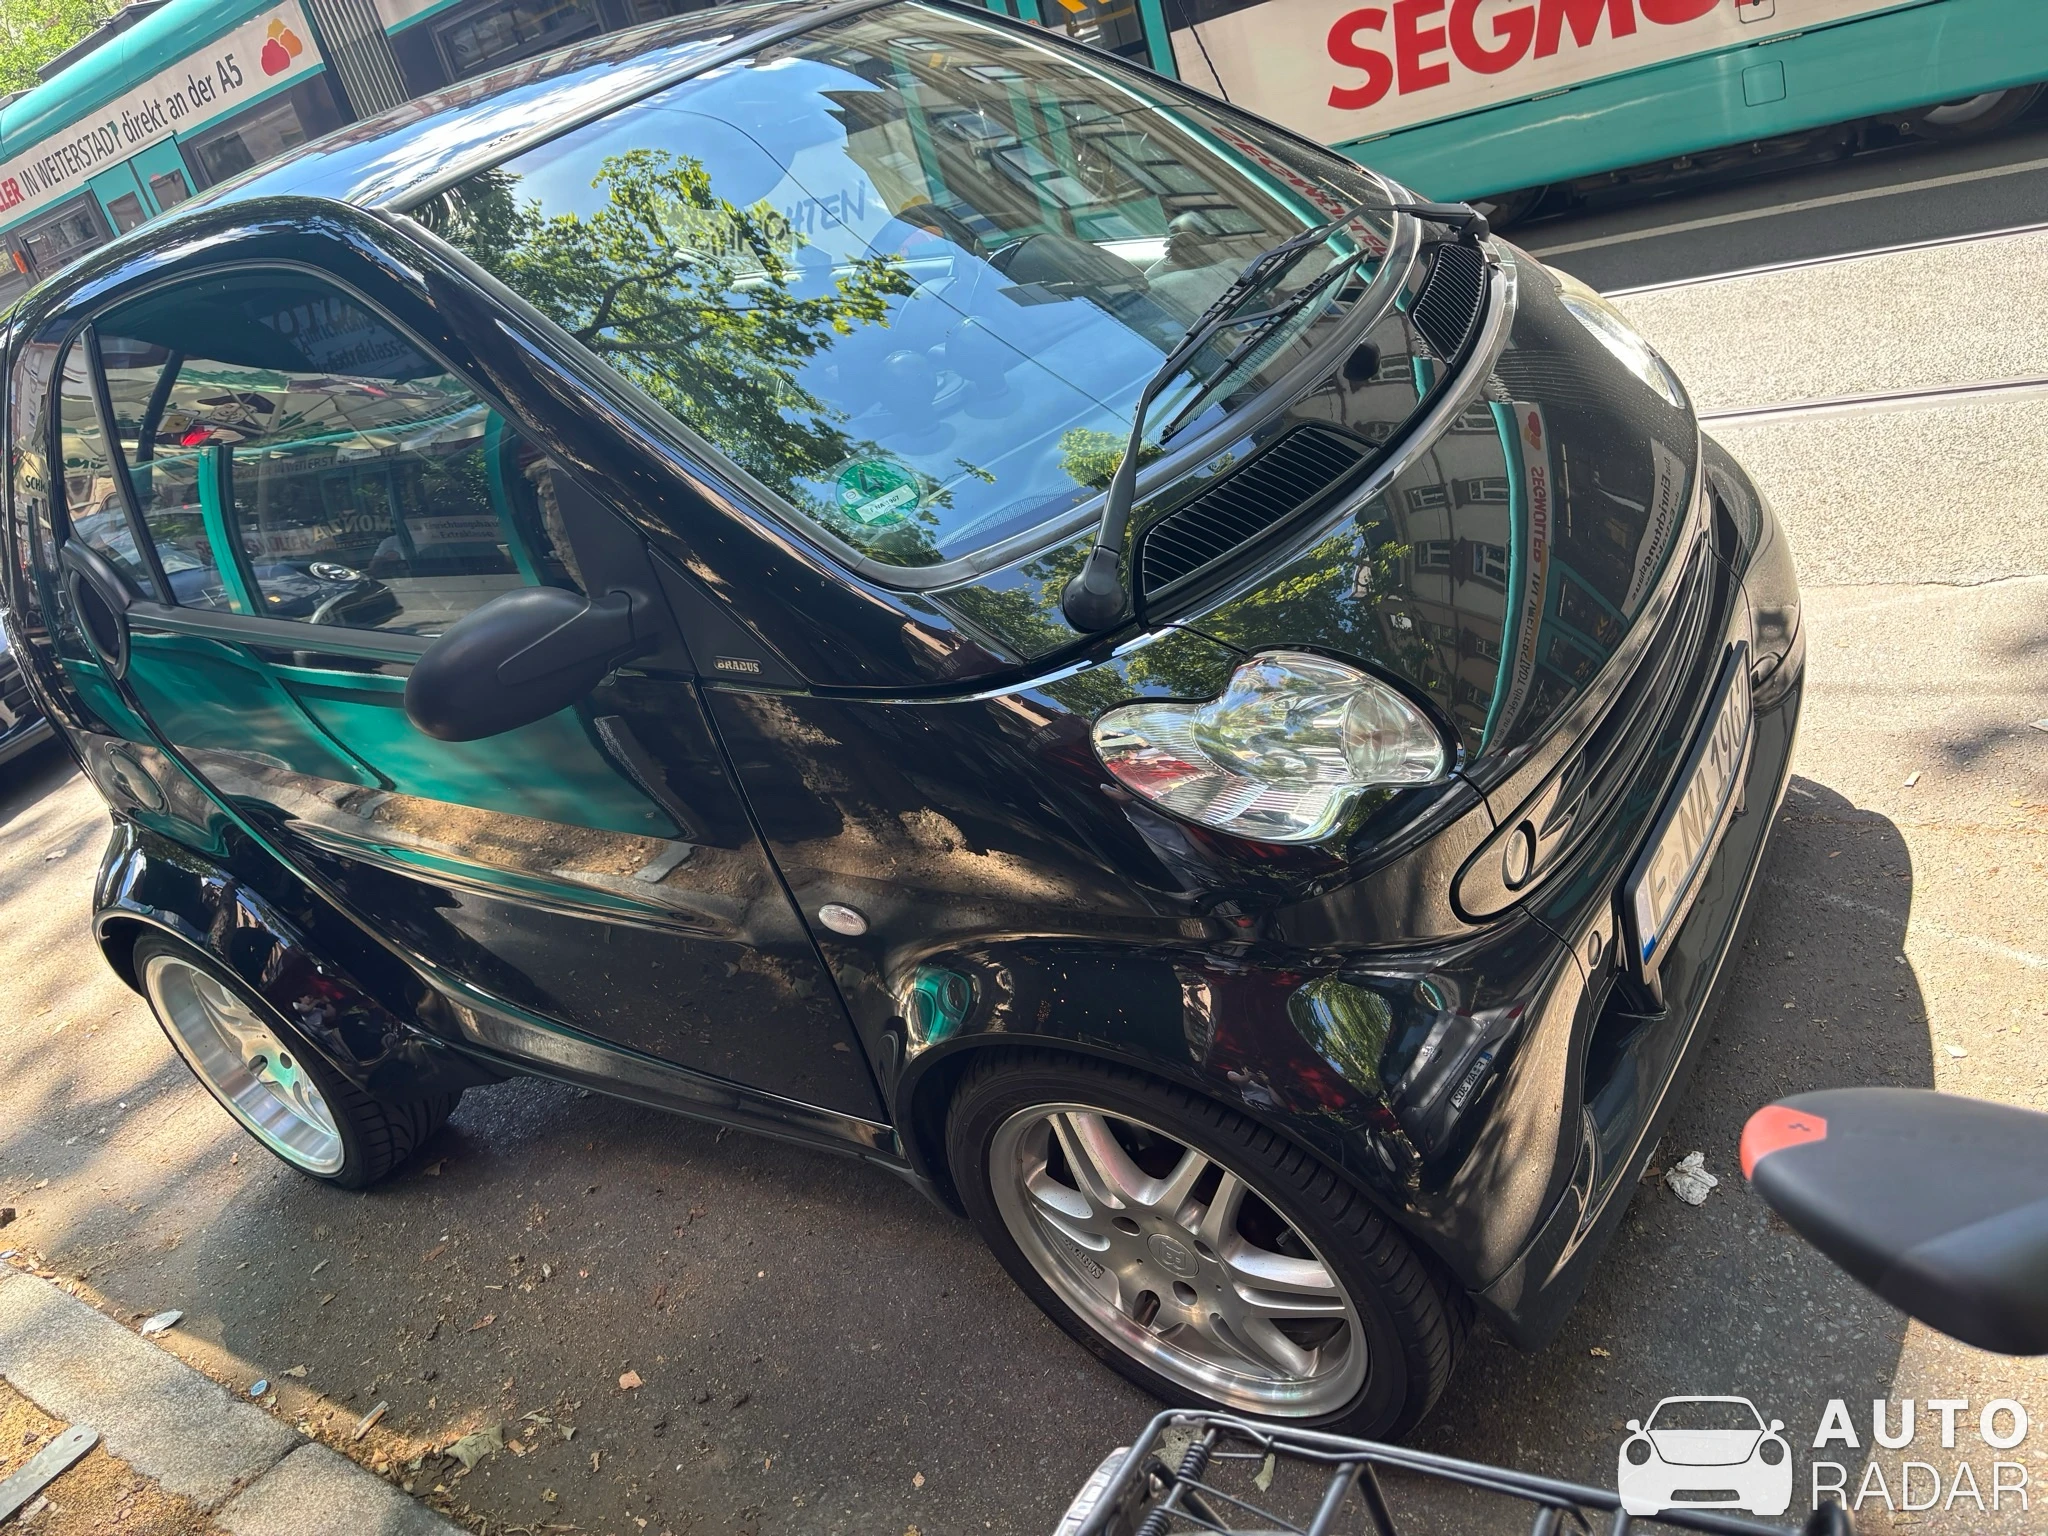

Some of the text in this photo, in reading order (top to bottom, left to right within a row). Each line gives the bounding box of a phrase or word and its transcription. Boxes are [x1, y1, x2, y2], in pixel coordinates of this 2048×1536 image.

[19, 168, 41, 197] IN
[33, 121, 122, 189] WEITERSTADT
[122, 99, 169, 144] direkt
[165, 92, 190, 120] an
[187, 74, 217, 109] der
[216, 53, 243, 94] A5
[1648, 845, 1667, 928] F
[1679, 767, 1714, 867] NA
[1711, 659, 1747, 802] 1967
